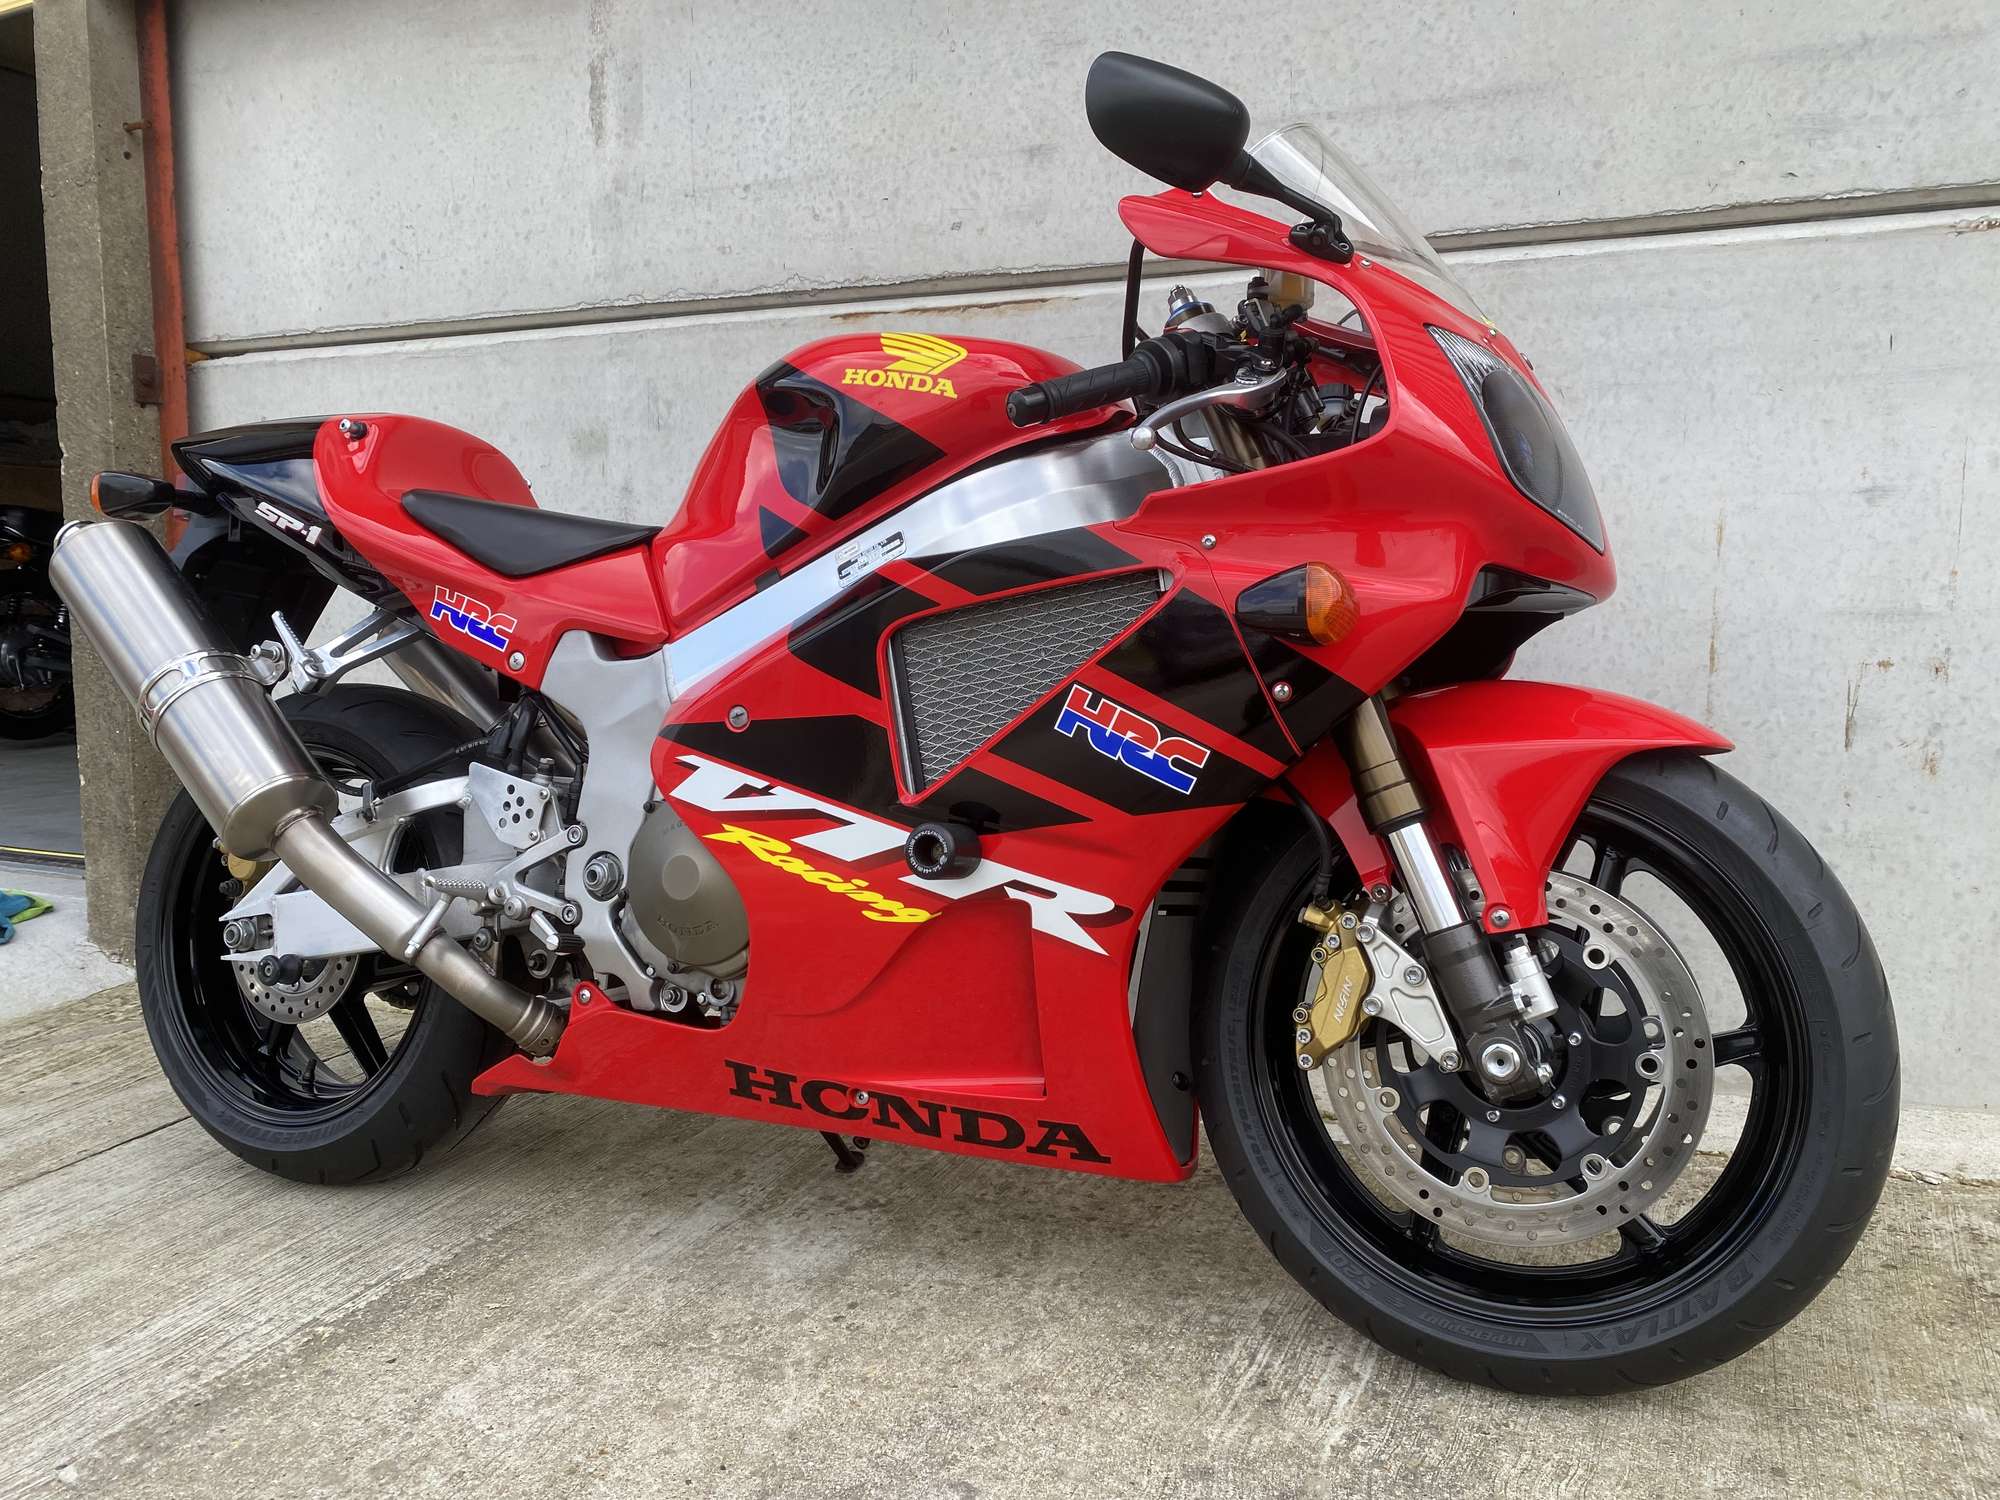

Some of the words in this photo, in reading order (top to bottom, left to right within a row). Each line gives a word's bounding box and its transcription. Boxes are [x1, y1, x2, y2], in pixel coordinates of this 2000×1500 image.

[842, 368, 958, 399] HONDA
[429, 584, 518, 652] HRC
[1054, 683, 1211, 795] HRC
[702, 823, 943, 923] Racing
[724, 1059, 1112, 1164] HONDA
